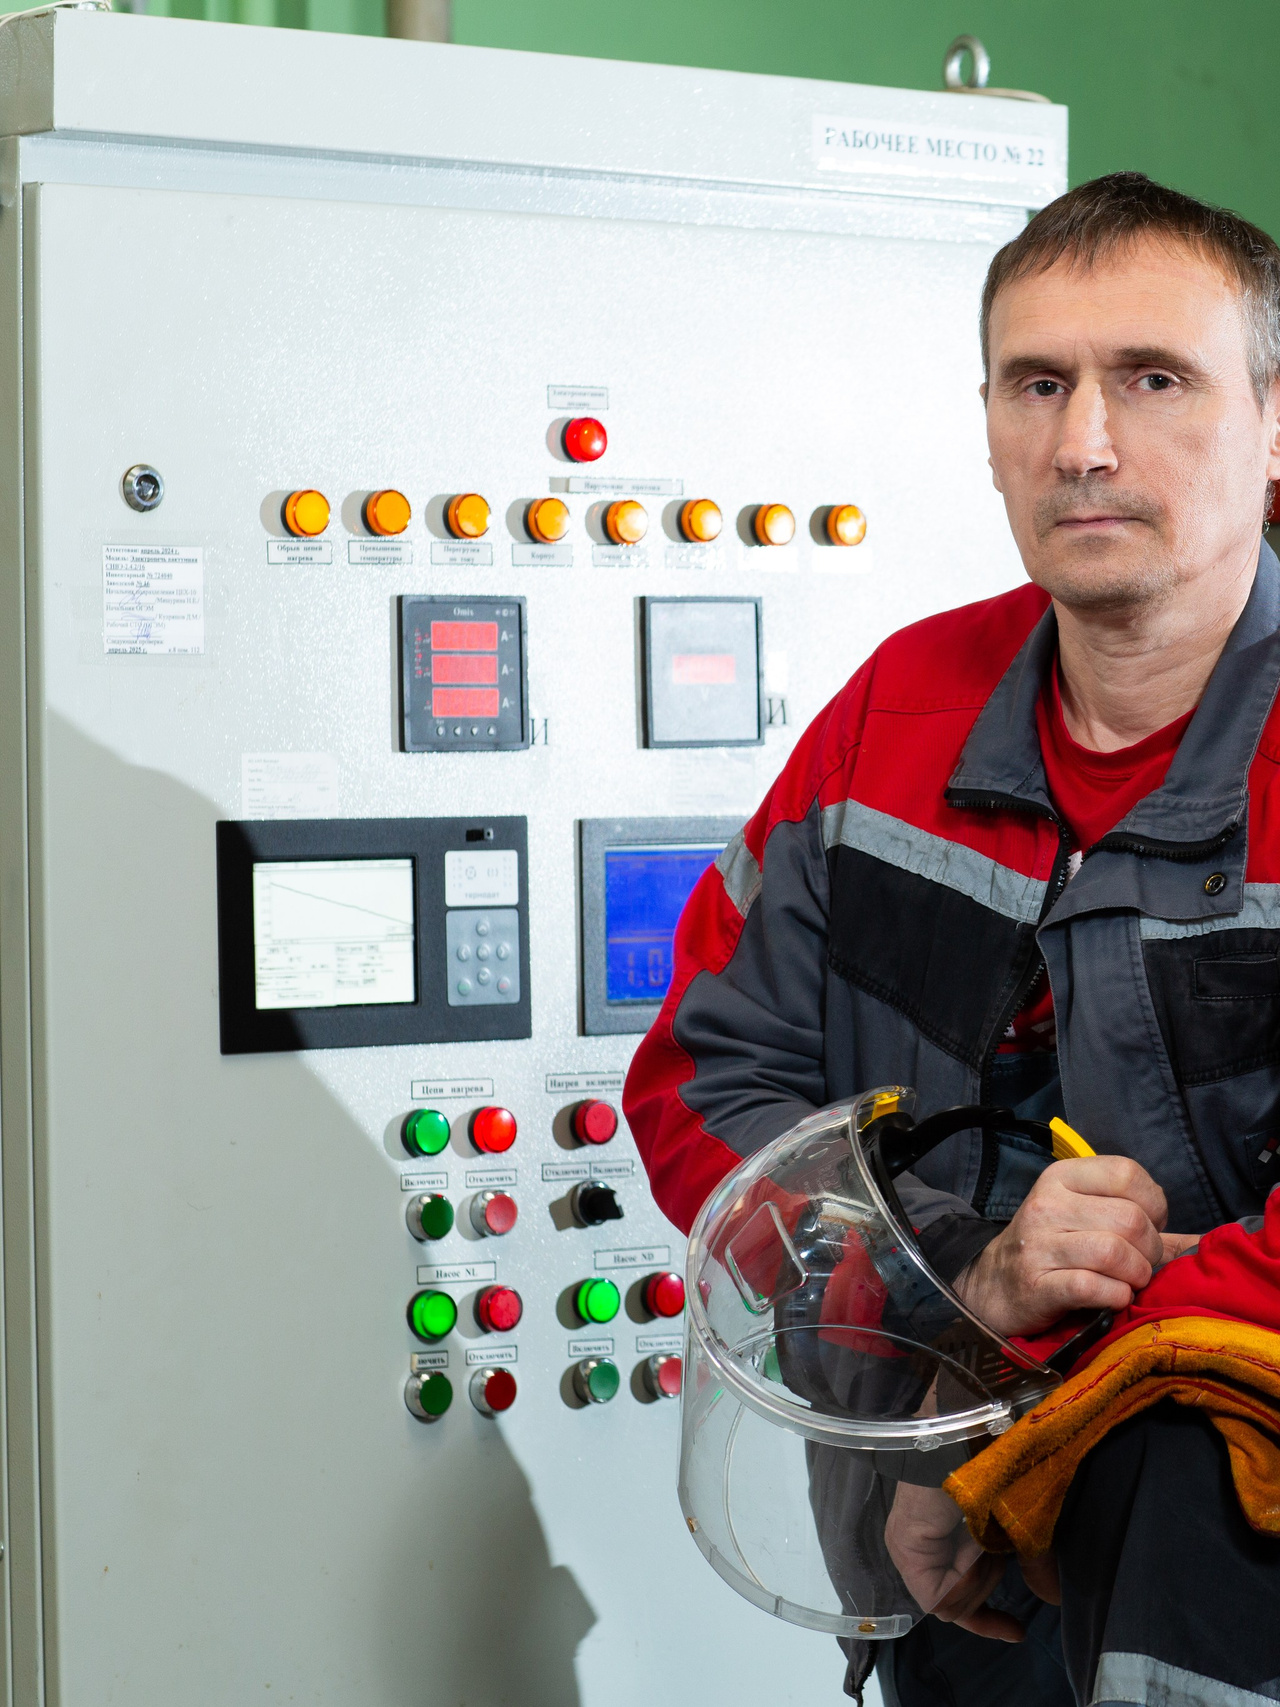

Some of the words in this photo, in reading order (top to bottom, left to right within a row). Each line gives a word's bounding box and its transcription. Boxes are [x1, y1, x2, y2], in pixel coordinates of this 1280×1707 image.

[825, 127, 919, 154] РАБОЧЕЕ
[926, 138, 998, 161] МЕСТО
[1003, 146, 1021, 164] №
[1028, 148, 1045, 166] 22
[550, 1078, 579, 1090] Нагрев
[422, 1085, 445, 1097] Цепи
[450, 1084, 484, 1096] нагрева
[545, 1167, 588, 1178] Отключить
[592, 1165, 633, 1175] Включить
[404, 1176, 445, 1187] Включить
[468, 1174, 513, 1185] Отключить
[614, 1253, 638, 1264] Насос
[436, 1268, 461, 1280] Насос
[465, 1267, 478, 1278] NL
[573, 1342, 610, 1354] Включить
[468, 1351, 513, 1362] Отключить
